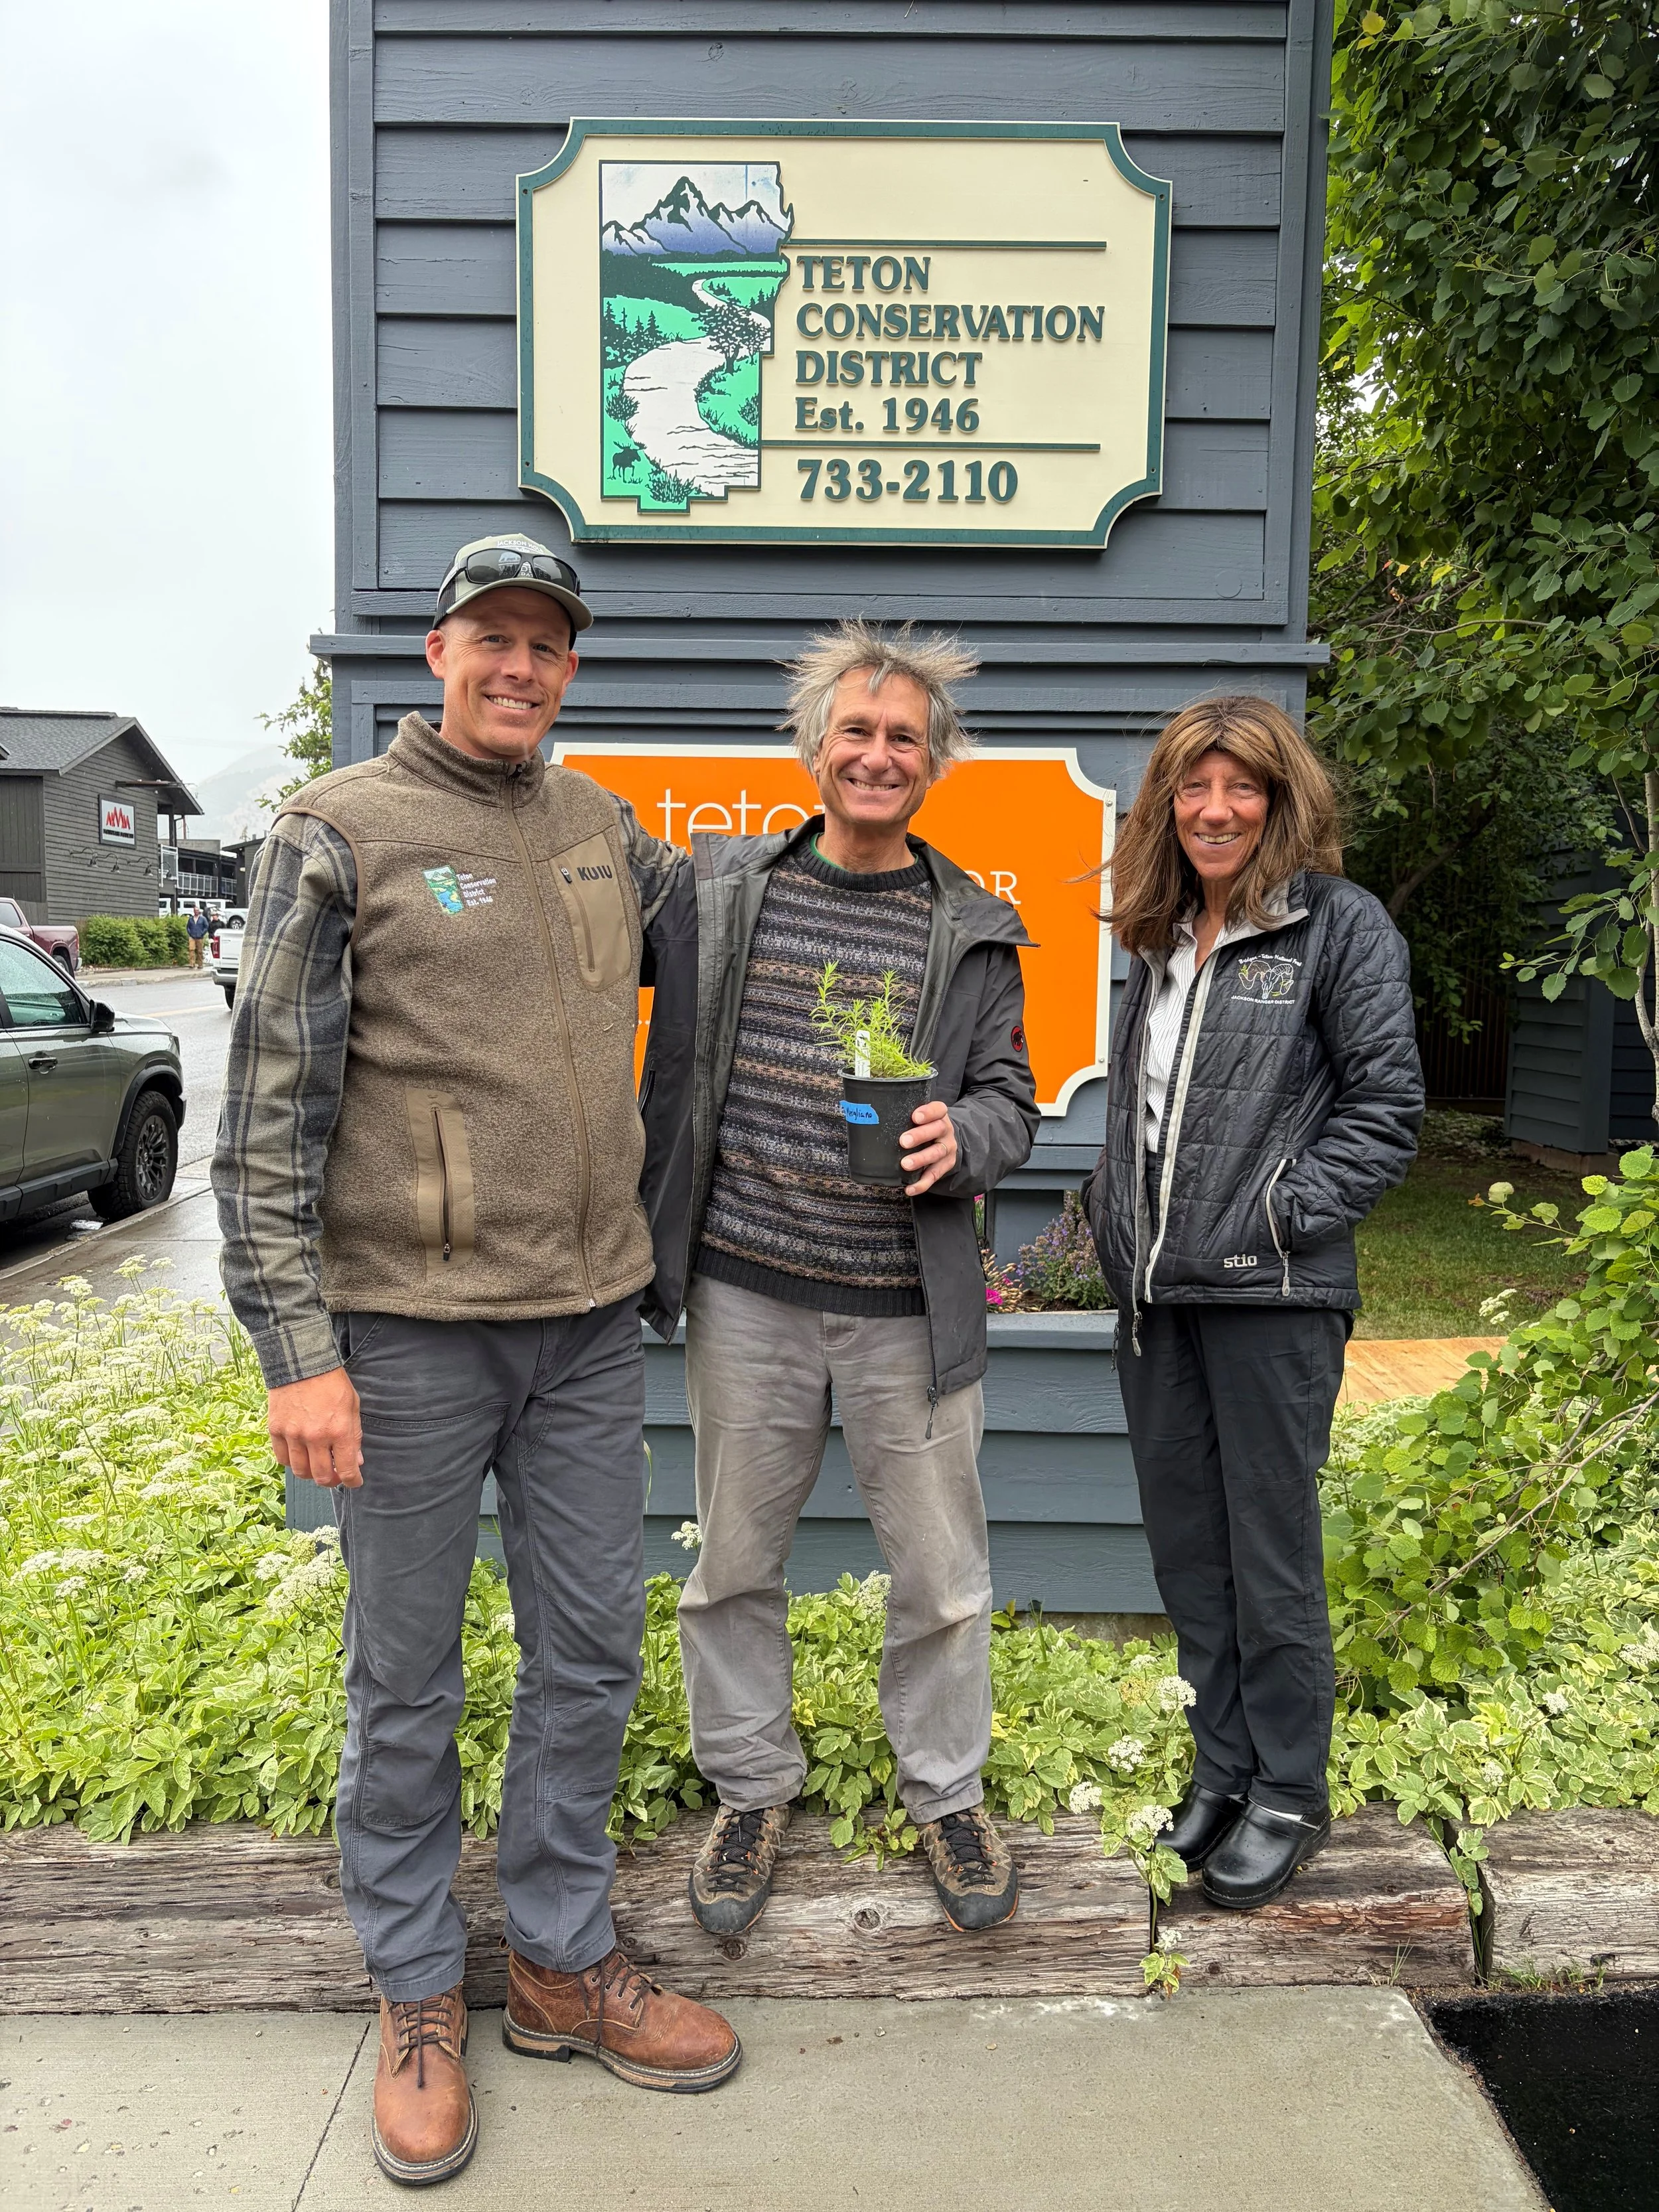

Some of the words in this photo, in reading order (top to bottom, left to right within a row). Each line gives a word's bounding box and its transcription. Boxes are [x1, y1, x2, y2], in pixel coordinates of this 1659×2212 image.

[796, 256, 931, 291] TETON
[796, 303, 1106, 341] CONSERVATION
[796, 350, 983, 386] DISTRICT
[795, 397, 865, 431] Est.
[882, 398, 980, 433] 1946
[797, 459, 1019, 504] 733-2110
[456, 873, 473, 881] Teton
[577, 865, 613, 881] KUIU
[460, 877, 497, 889] Conservation
[463, 888, 486, 898] District
[480, 895, 494, 904] 1946
[1223, 1253, 1258, 1269] stio
